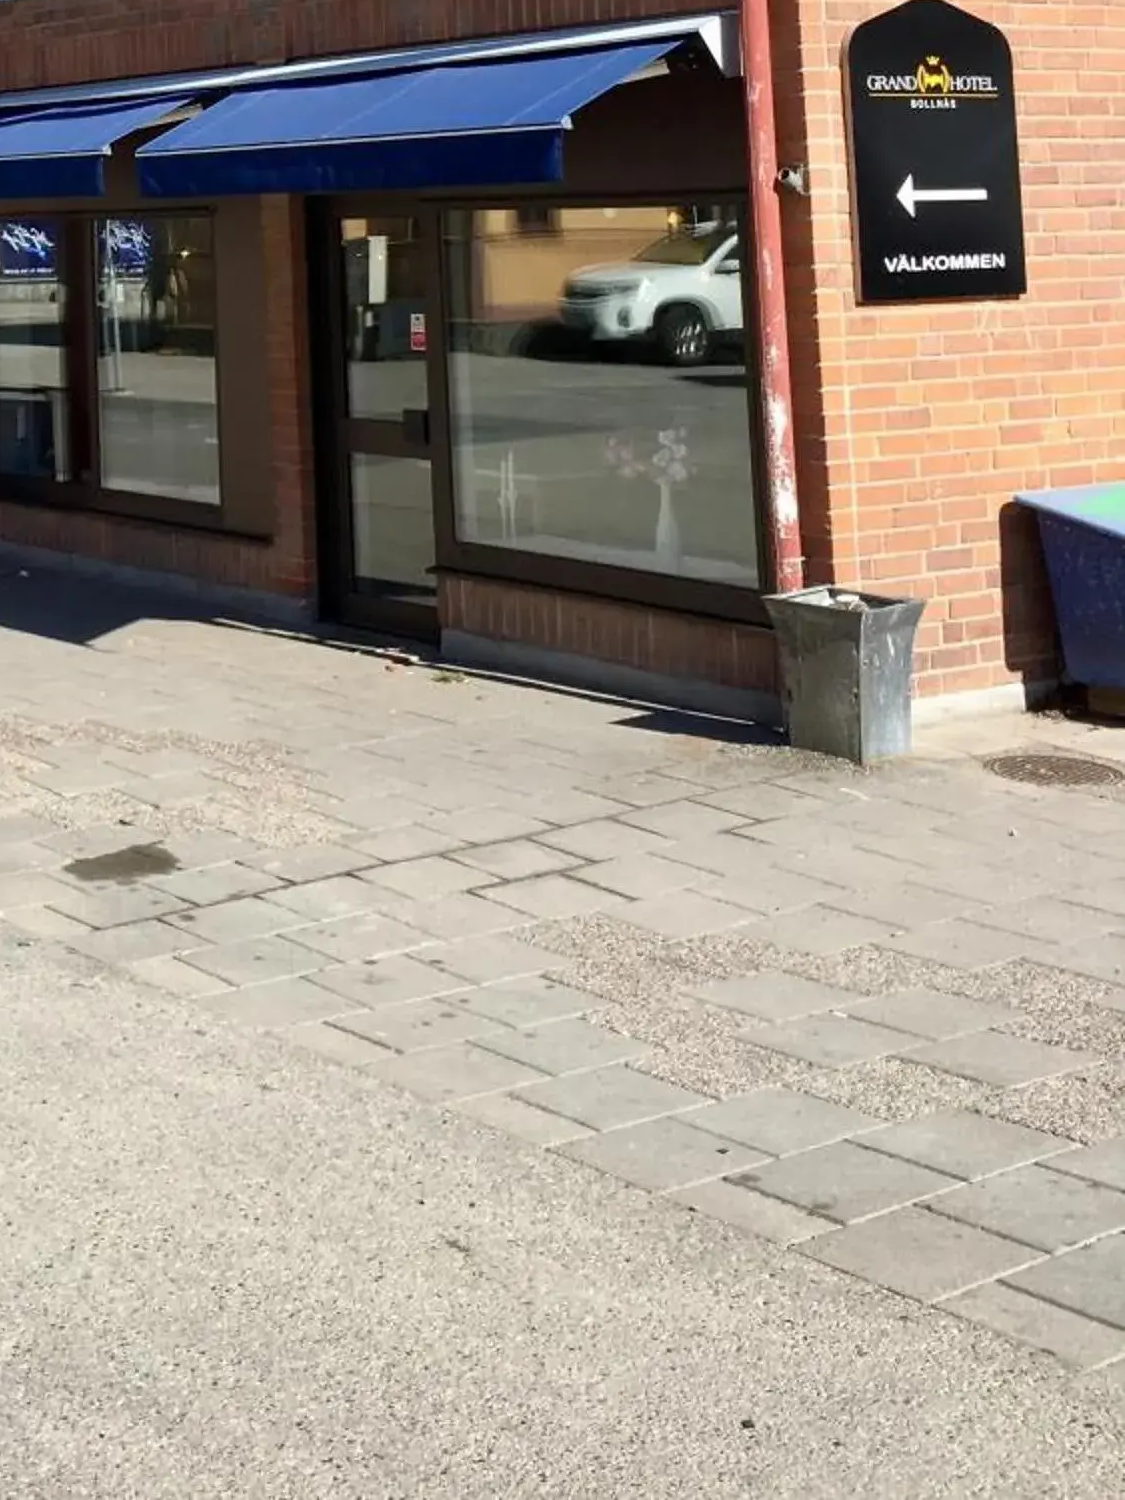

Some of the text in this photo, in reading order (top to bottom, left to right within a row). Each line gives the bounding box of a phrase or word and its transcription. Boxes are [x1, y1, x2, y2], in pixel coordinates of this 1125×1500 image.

[866, 75, 998, 91] GRAND HOTEL
[884, 252, 1007, 273] VÄLKOMMEN
